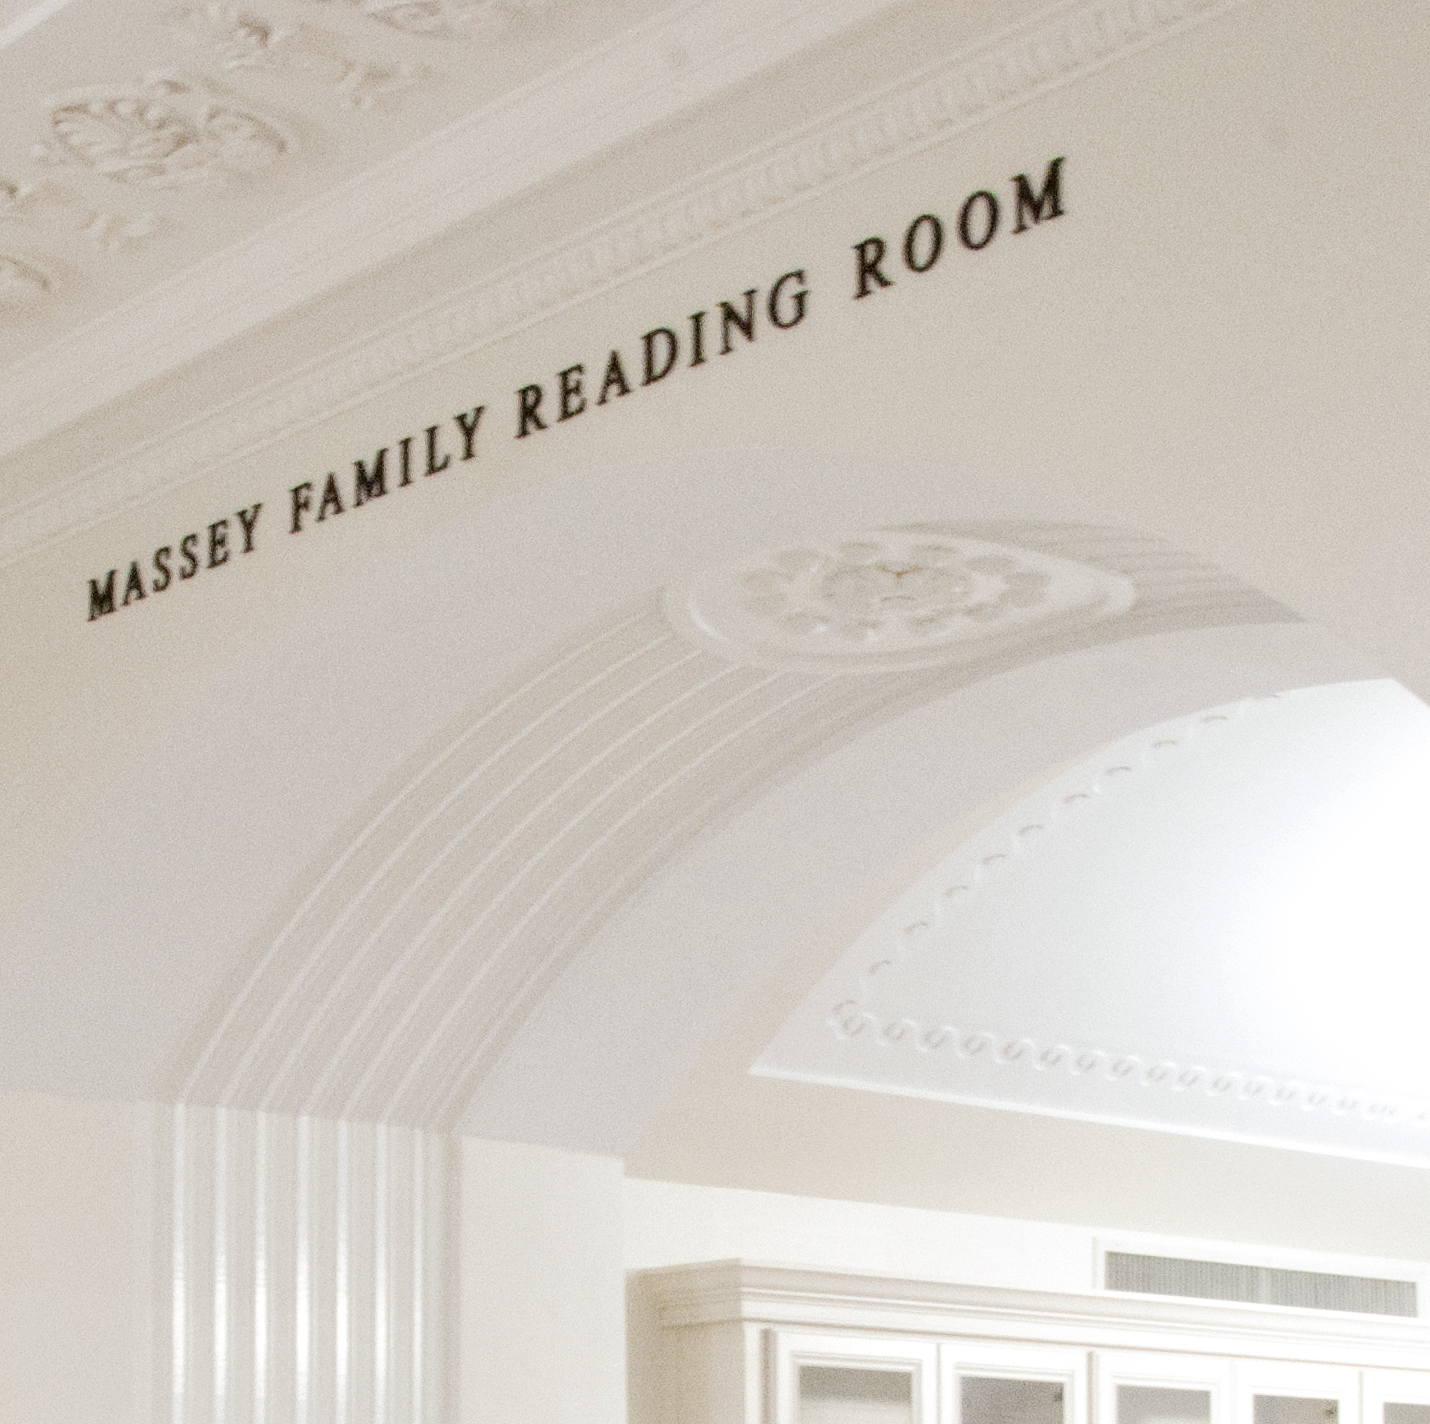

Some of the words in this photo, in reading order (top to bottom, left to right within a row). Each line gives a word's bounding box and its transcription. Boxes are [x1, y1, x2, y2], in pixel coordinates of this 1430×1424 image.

[87, 502, 264, 623] MASSEY
[290, 405, 487, 535] FAMILY
[514, 268, 811, 440] READING
[852, 156, 1067, 301] ROOM
